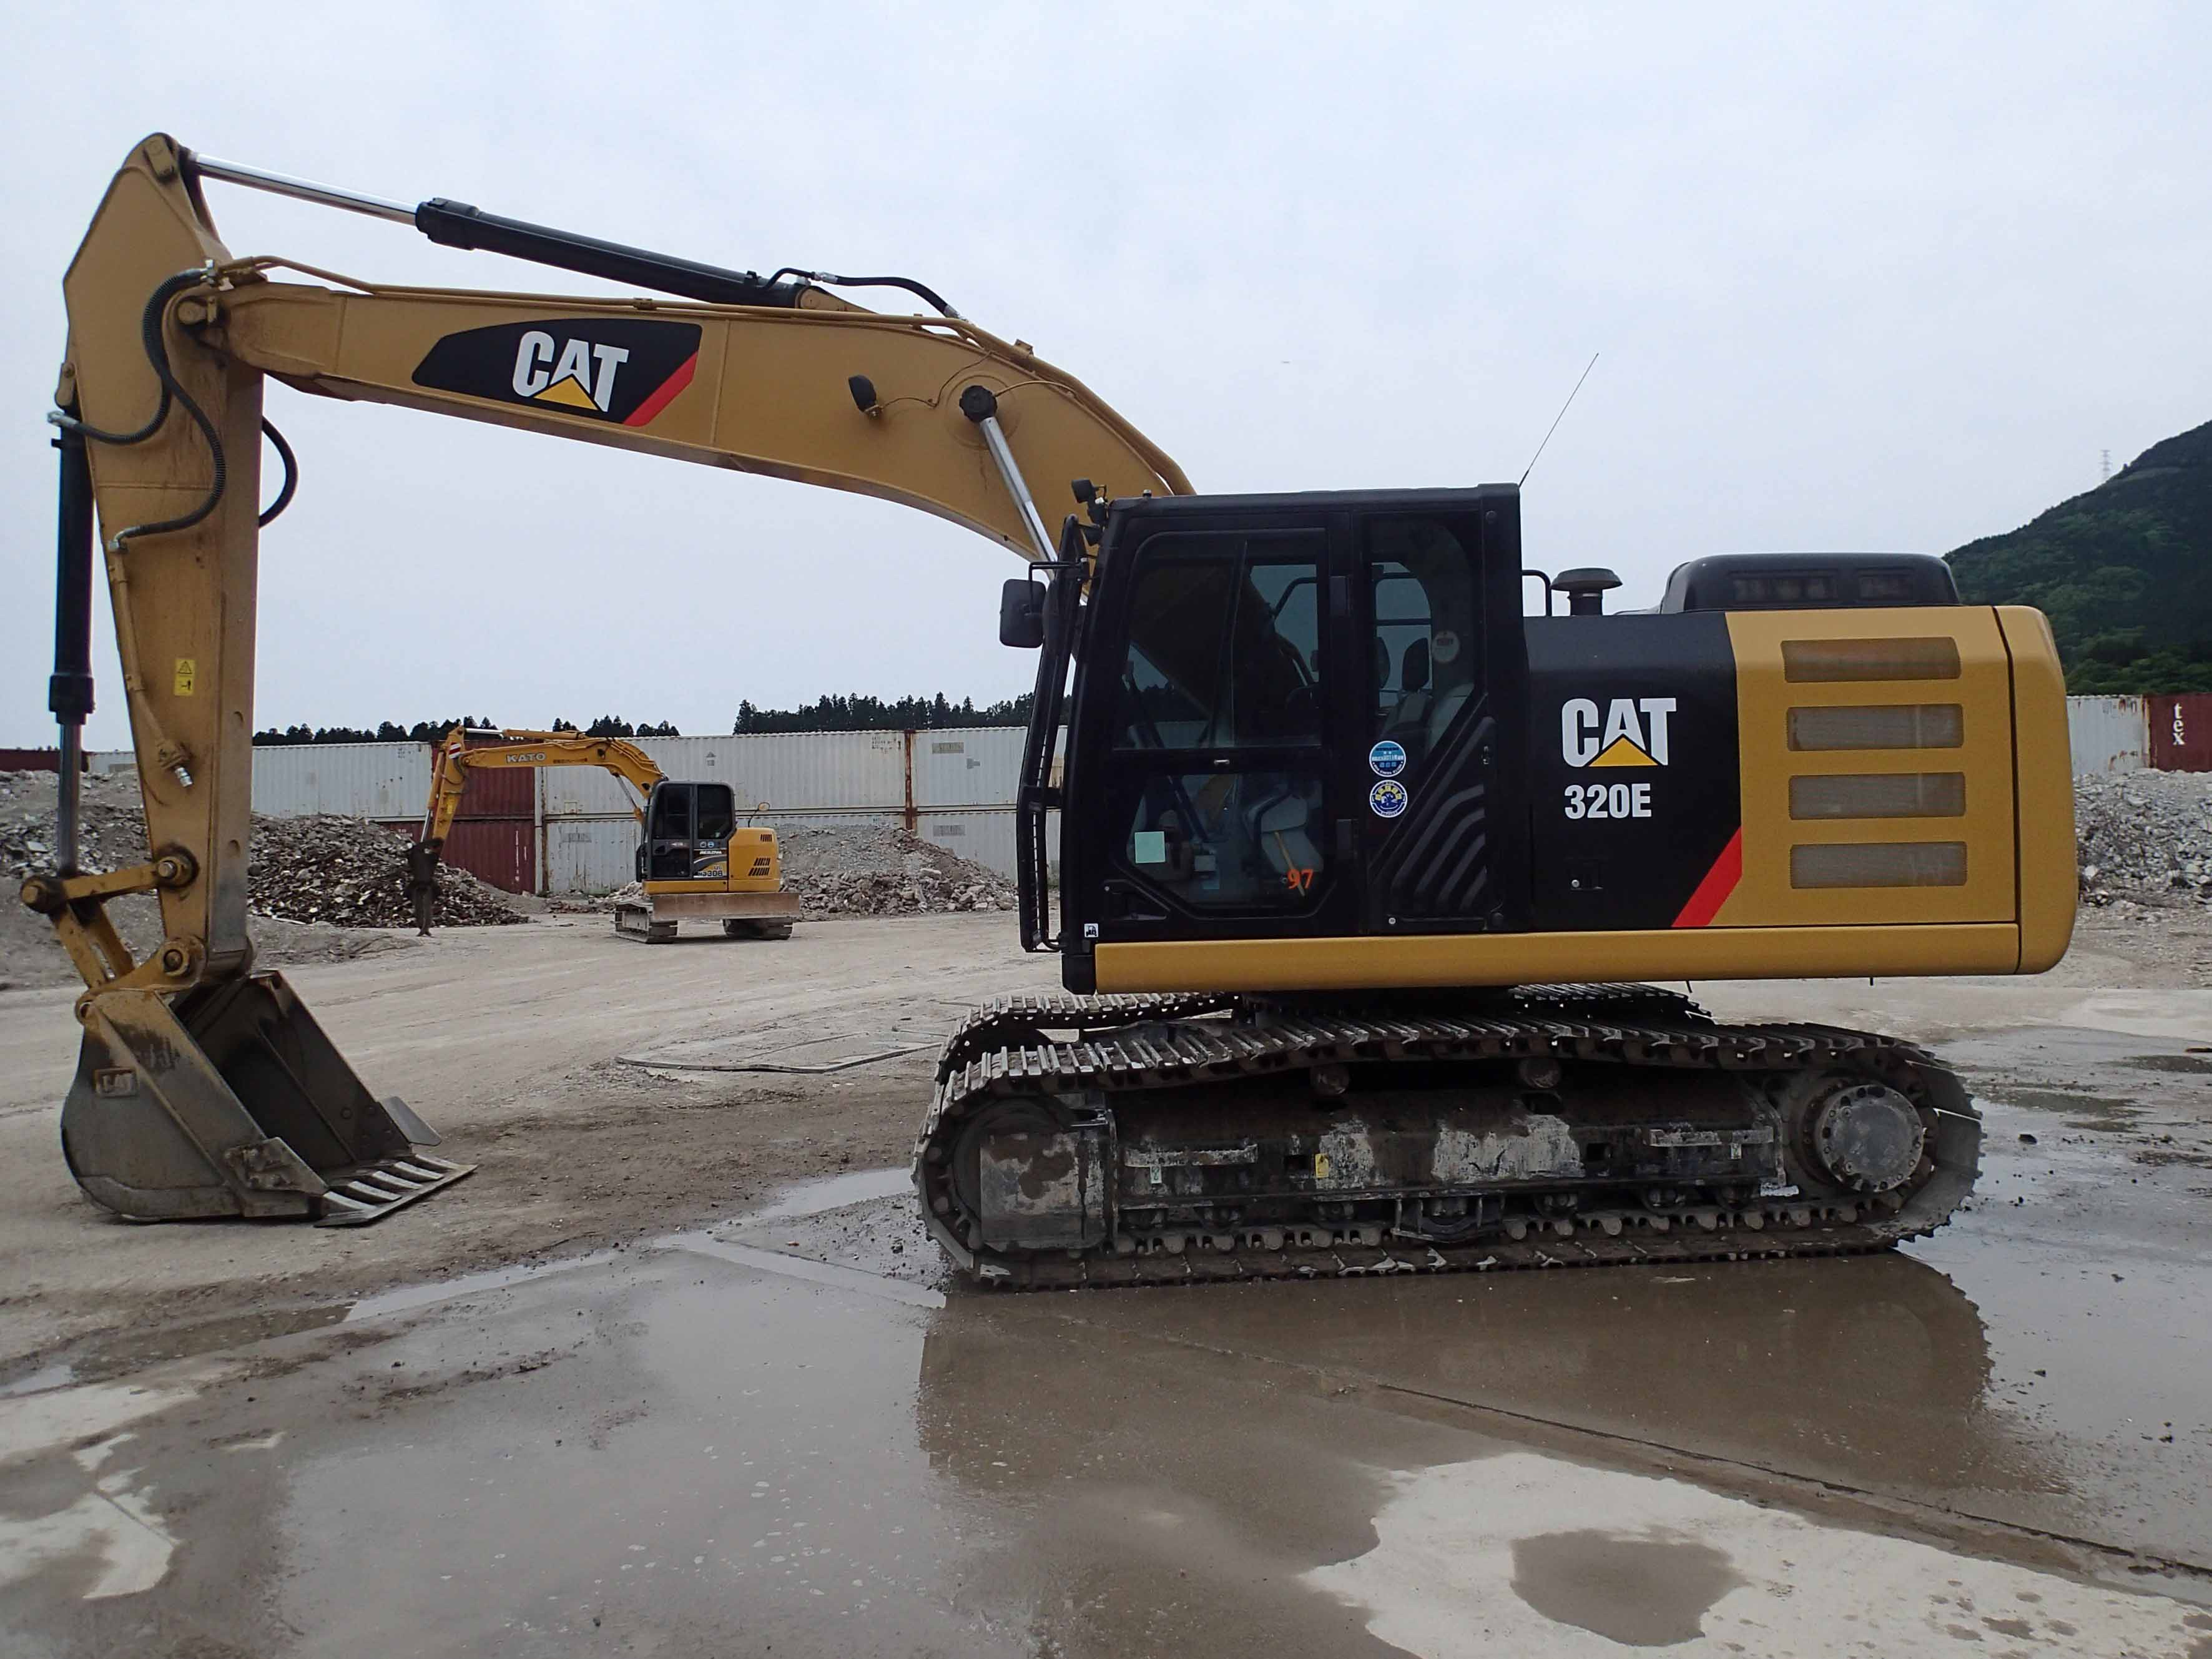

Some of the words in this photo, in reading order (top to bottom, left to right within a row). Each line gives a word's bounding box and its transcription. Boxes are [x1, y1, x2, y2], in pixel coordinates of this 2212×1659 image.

[512, 331, 629, 412] CAT
[1561, 698, 1677, 767] CAT
[506, 752, 546, 763] KATO
[1565, 783, 1651, 819] 320E
[1287, 869, 1314, 889] 97
